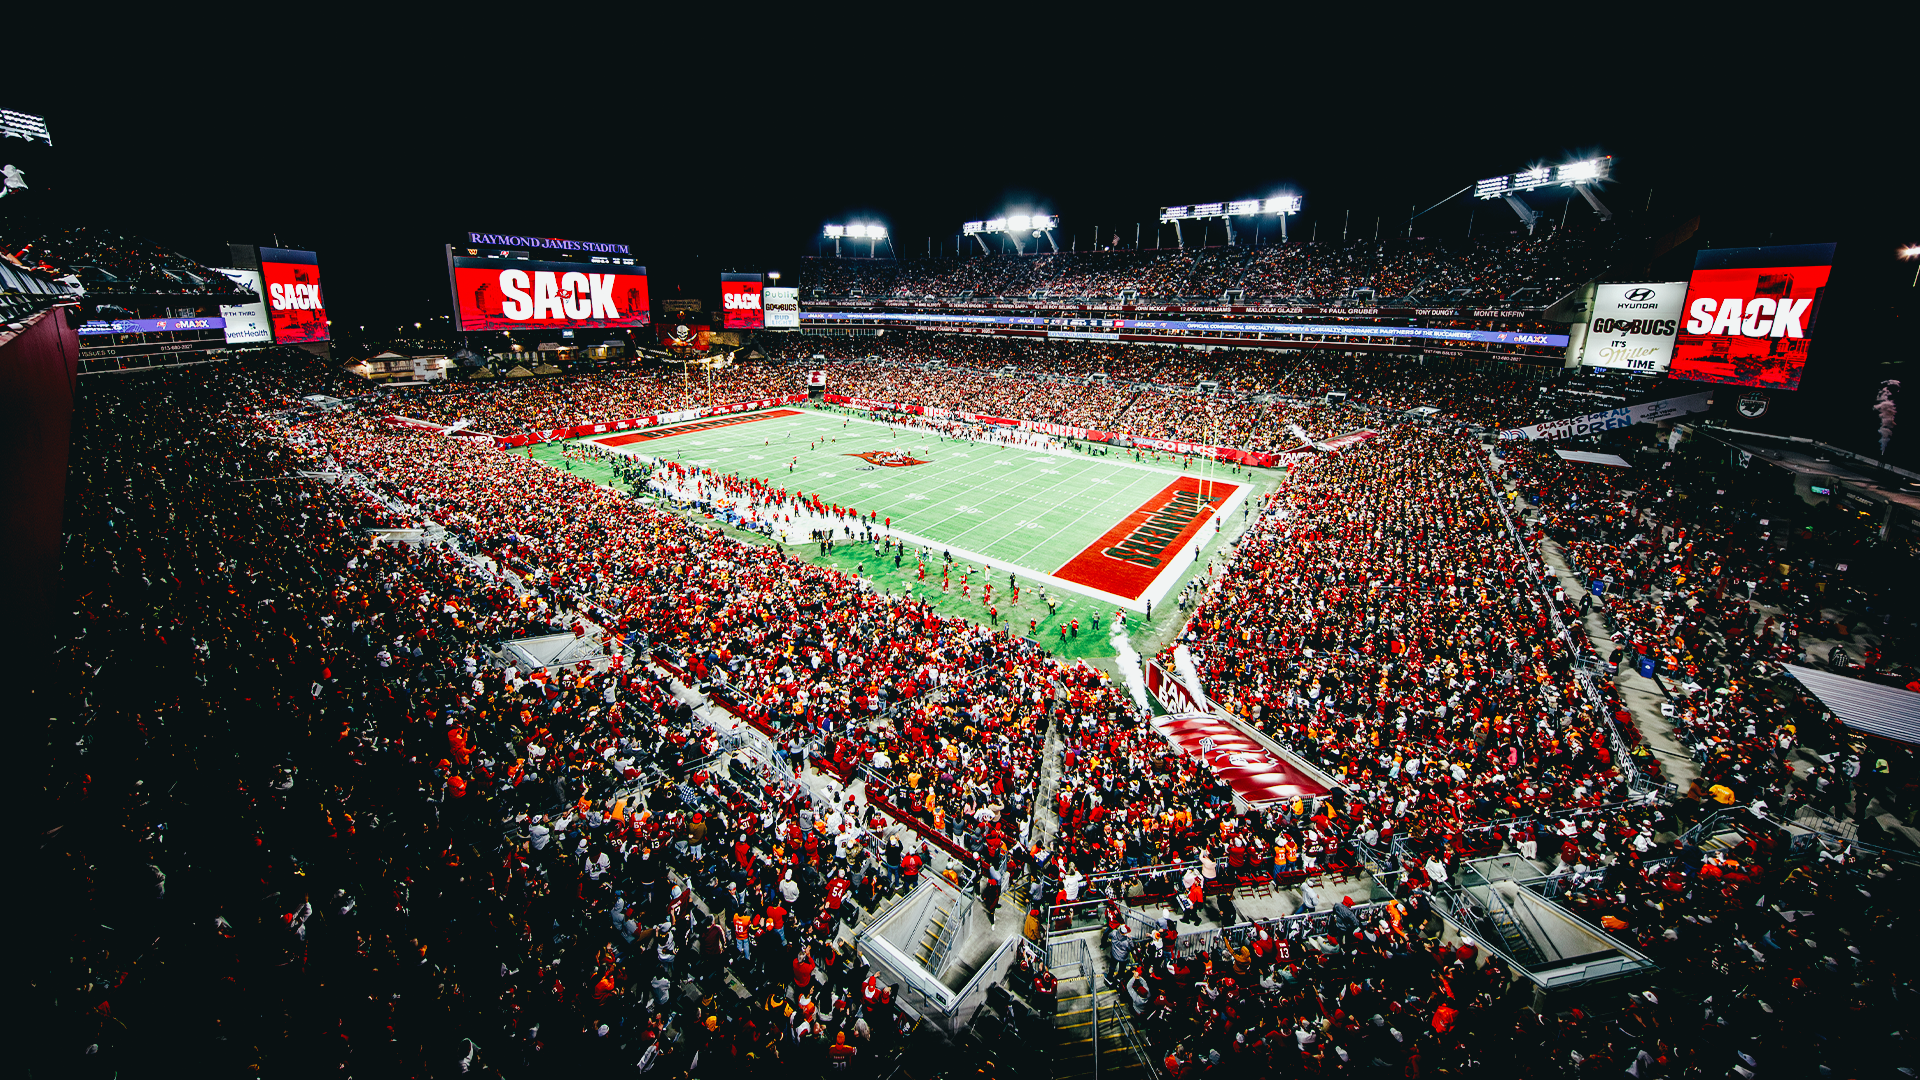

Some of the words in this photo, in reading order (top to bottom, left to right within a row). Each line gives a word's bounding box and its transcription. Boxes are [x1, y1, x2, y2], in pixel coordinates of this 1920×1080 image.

[472, 233, 540, 248] RAYMOND
[542, 238, 580, 250] JAMES
[583, 242, 629, 254] STADIUM
[270, 283, 322, 310] SACK
[499, 269, 620, 320] SACK
[765, 290, 794, 298] Publix
[724, 293, 761, 310] SACK
[766, 303, 774, 311] GO
[780, 303, 797, 311] BUCS
[1474, 310, 1498, 318] MONTE
[1686, 298, 1812, 338] SACK
[176, 320, 210, 328] eMAXX
[1593, 318, 1615, 334] GO
[1630, 319, 1676, 336] BUCS
[227, 329, 268, 338] ventHealth
[1514, 335, 1548, 344] eMAXX
[1611, 340, 1626, 348] IT'S
[1599, 346, 1660, 365] Miller
[1627, 359, 1656, 370] TIME
[1536, 416, 1584, 432] GLASSES
[1588, 412, 1608, 422] FOR
[1611, 406, 1631, 418] ALL
[1154, 440, 1176, 451] GO
[1178, 444, 1218, 457] BUCS
[1014, 520, 1038, 529] 10
[831, 887, 844, 898] 54
[674, 906, 682, 916] 7
[735, 924, 744, 933] 13
[1280, 948, 1289, 959] 13
